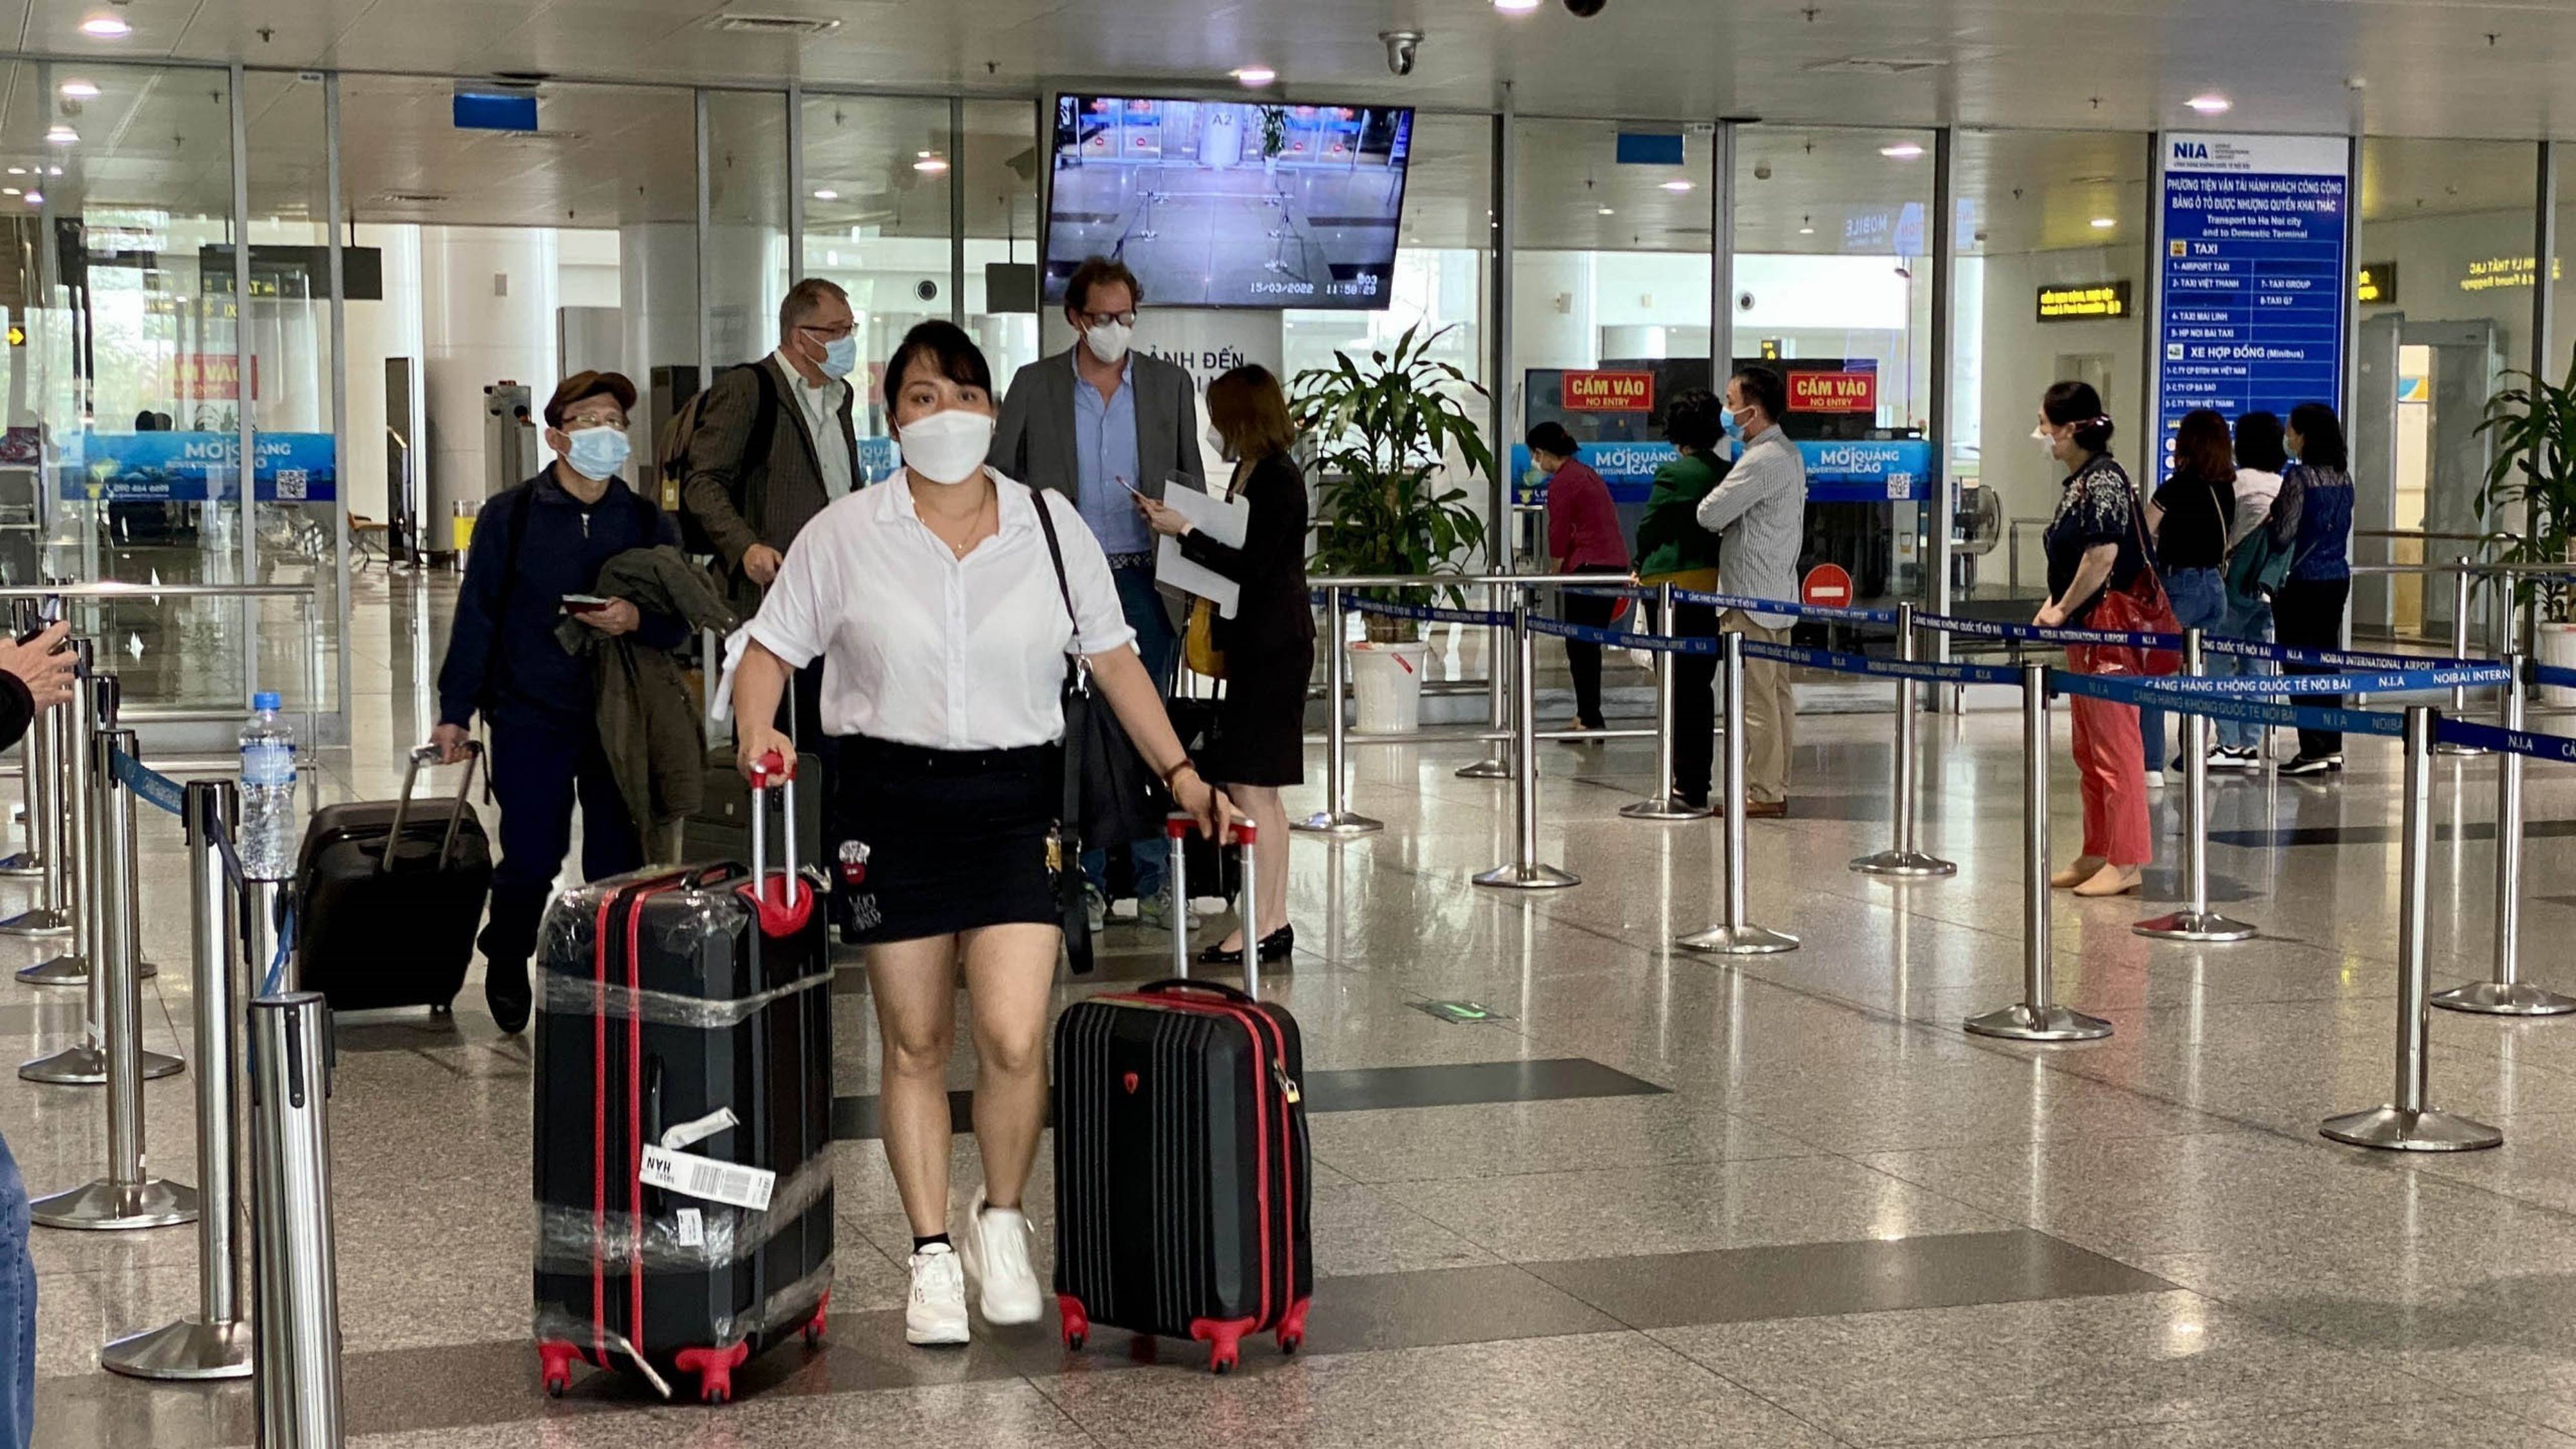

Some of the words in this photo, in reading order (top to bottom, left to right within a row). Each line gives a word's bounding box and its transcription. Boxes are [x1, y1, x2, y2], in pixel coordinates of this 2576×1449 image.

[1212, 114, 1232, 126] A2
[2174, 142, 2208, 158] NIA
[2207, 214, 2246, 225] Transport
[2248, 216, 2257, 225] to
[2258, 216, 2269, 225] Ha
[2271, 216, 2285, 226] Noi
[2287, 216, 2302, 228] city
[2202, 228, 2219, 237] and
[2221, 229, 2230, 237] to
[2231, 228, 2270, 238] Domestic
[2272, 229, 2308, 238] Terminal
[2194, 243, 2218, 255] TAXI
[2181, 262, 2212, 271] AIRPORT
[2214, 263, 2230, 271] TAXI
[1250, 282, 1314, 294] 15/03/2022
[2181, 278, 2197, 287] TAXI
[2269, 279, 2284, 289] TAXI
[2286, 279, 2311, 289] GROUP
[2180, 312, 2195, 321] TAXI
[2217, 329, 2234, 337] TAXI
[1203, 345, 1244, 369] ĐẾN
[2191, 346, 2205, 357] XE
[2208, 346, 2231, 361] HỢP
[1572, 375, 1609, 395] CẤM
[1613, 377, 1645, 395] VÀO
[1797, 375, 1832, 396] CẤM
[1837, 378, 1867, 396] VÀO
[1586, 397, 1600, 406] NO
[1603, 397, 1629, 406] ENTRY
[1810, 398, 1824, 406] NO
[1826, 398, 1853, 407] ENTRY
[2320, 652, 2344, 665] NOIBAI
[2346, 655, 2401, 671] INTERNATIONAL
[2217, 679, 2256, 692] KHÔNG
[2259, 679, 2290, 692] QUỐC
[2295, 677, 2308, 691] TẾ
[2311, 678, 2330, 692] NỘI
[2333, 677, 2351, 690] BÀI
[2378, 676, 2405, 687] N.I.A
[2433, 672, 2464, 684] NOIBAI
[2508, 735, 2533, 752] N.I.A
[647, 1157, 671, 1173] HAN
